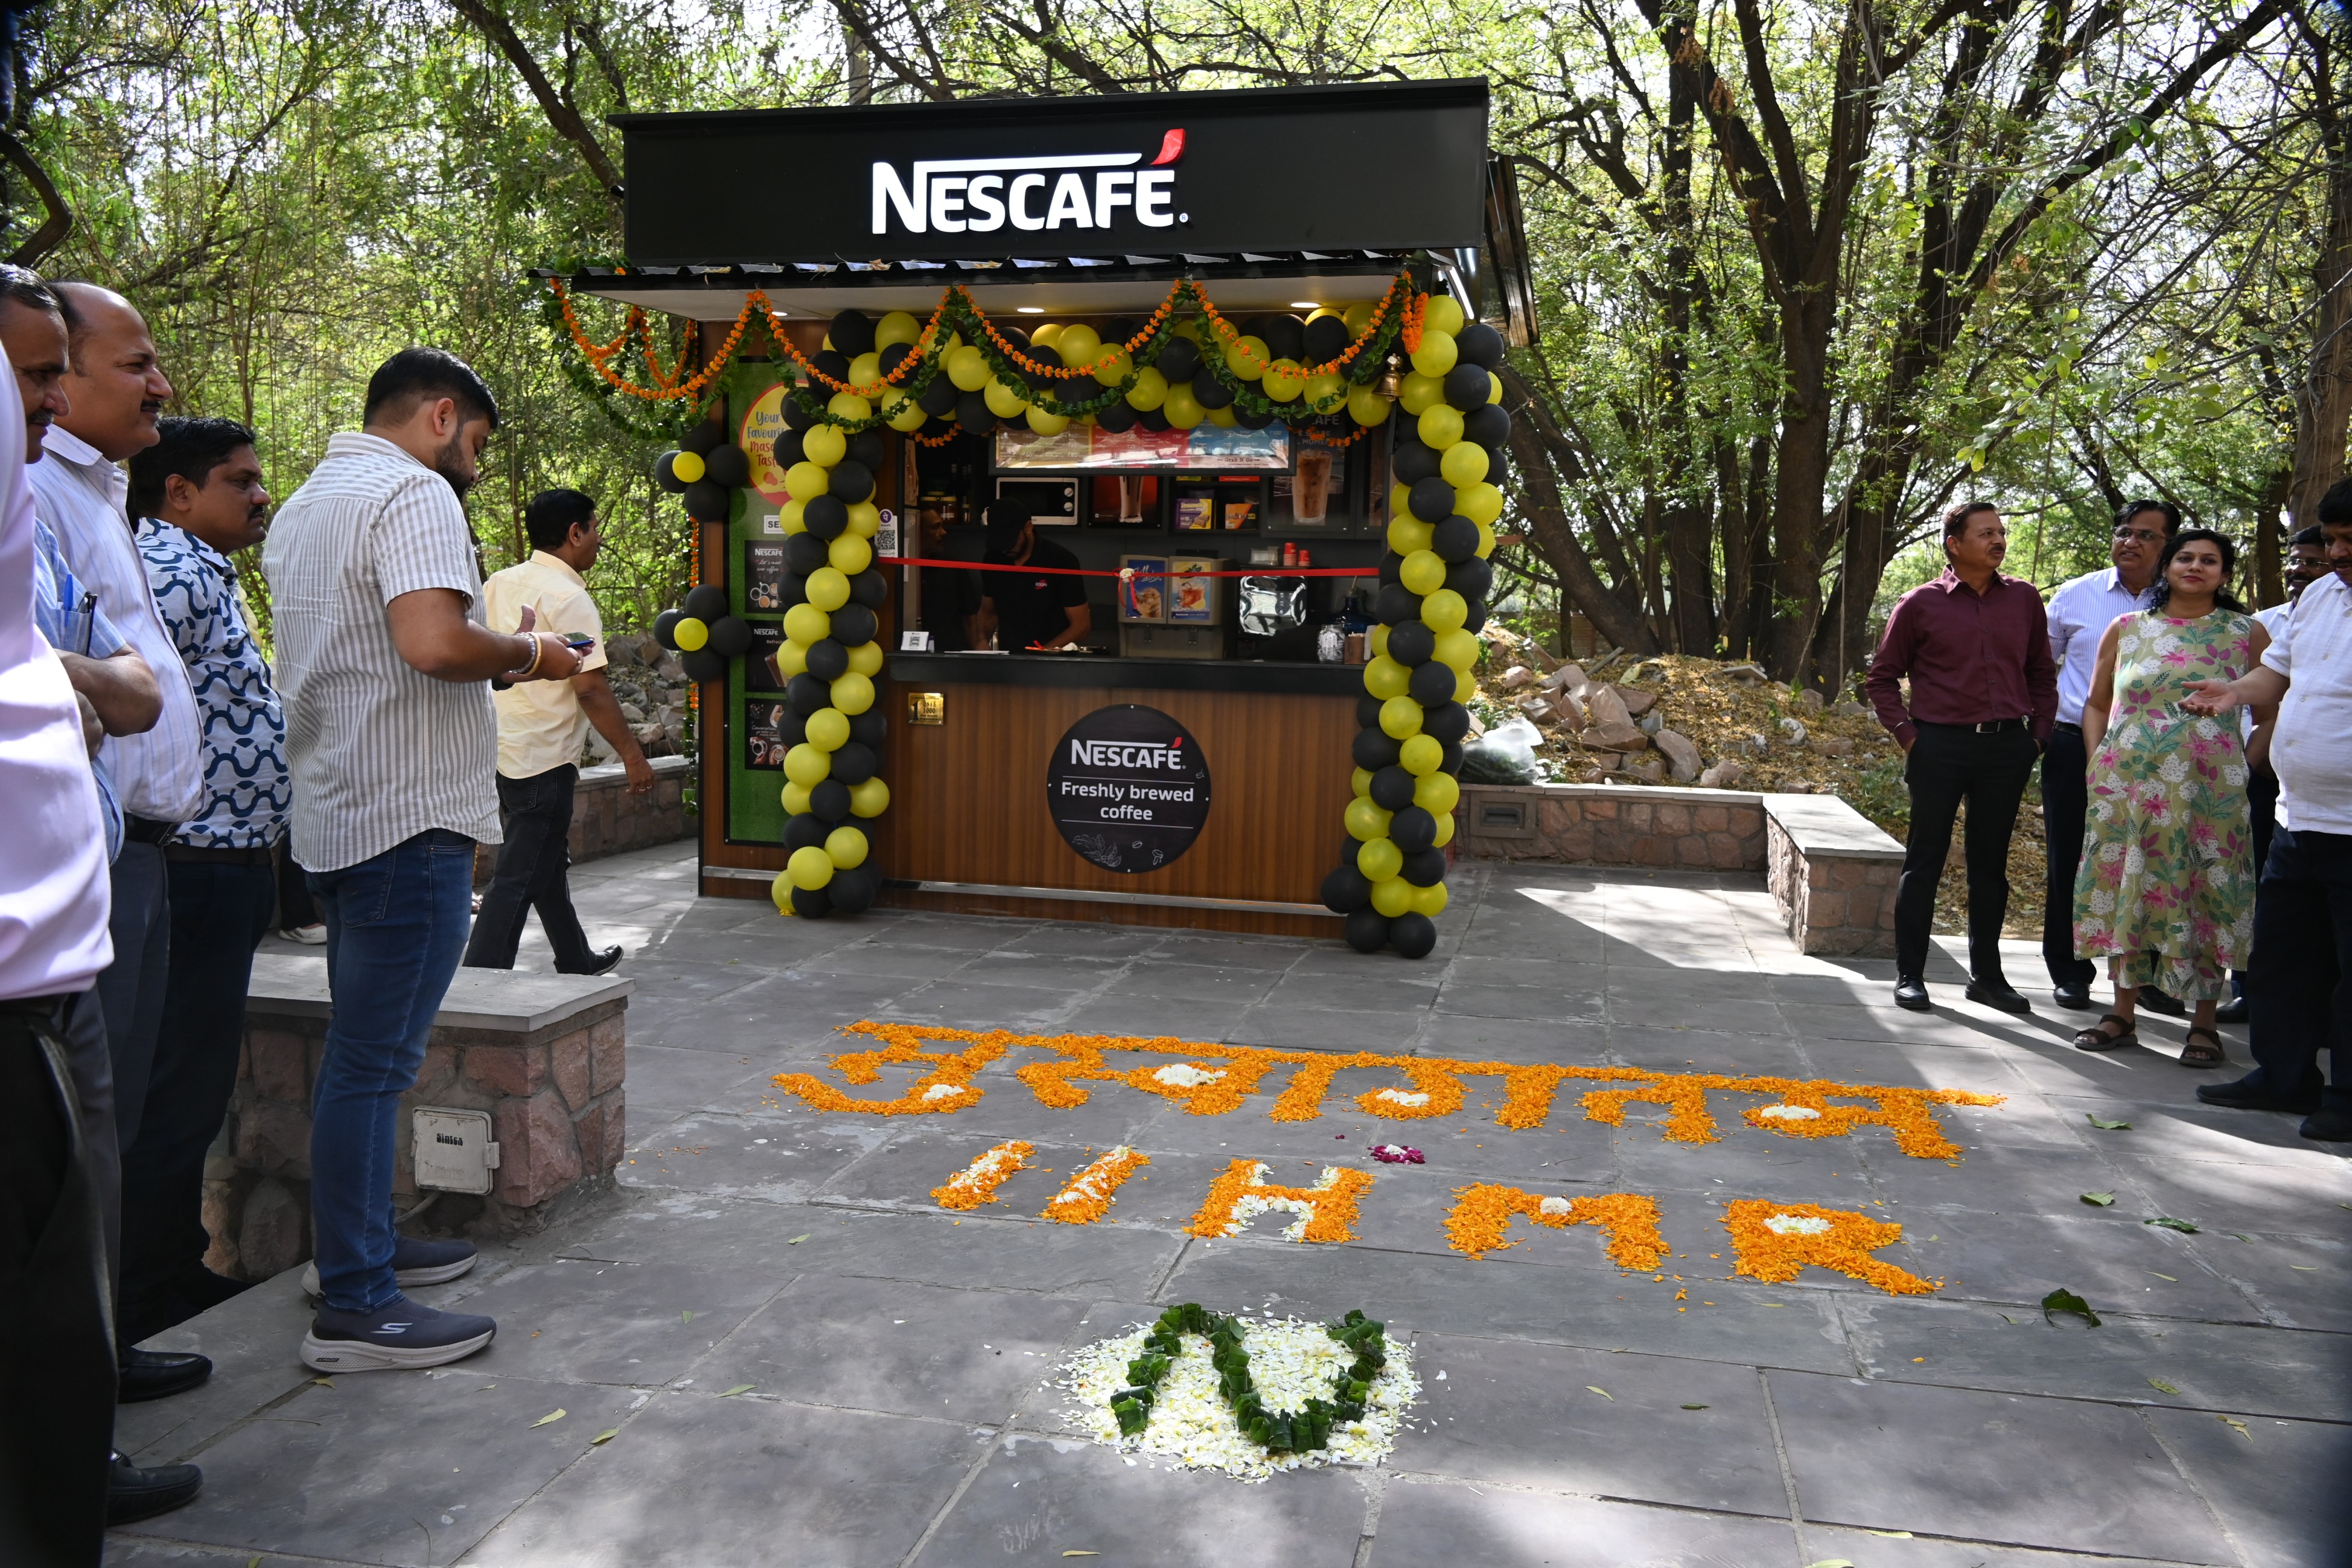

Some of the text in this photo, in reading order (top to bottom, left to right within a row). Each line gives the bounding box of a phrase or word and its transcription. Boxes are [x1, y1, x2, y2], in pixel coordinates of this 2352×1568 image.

[872, 129, 1184, 234] NESCAFÉ
[756, 412, 780, 425] Your
[766, 566, 779, 574] coffee
[1071, 737, 1182, 770] NESCAFÉ
[1062, 782, 1194, 802] Freshly brewed
[1100, 805, 1153, 821] coffee
[436, 1133, 464, 1146] Sintex
